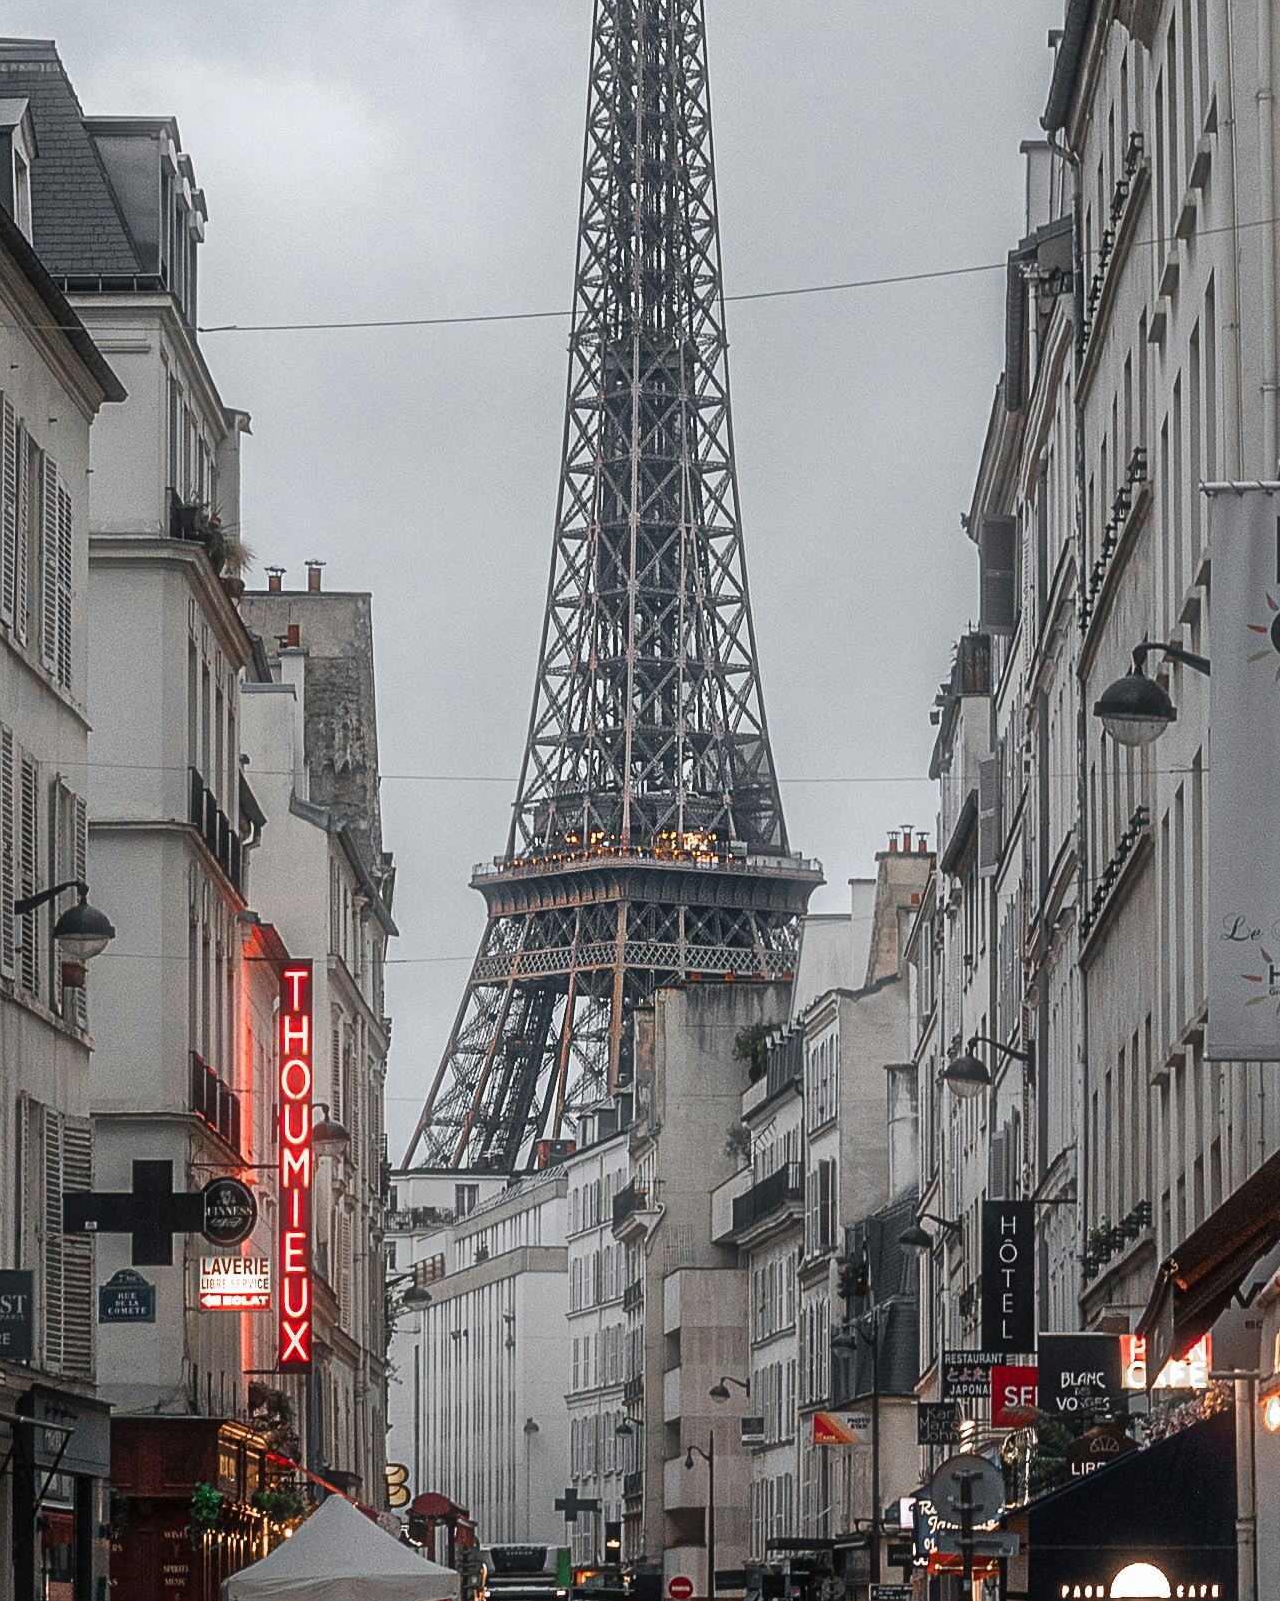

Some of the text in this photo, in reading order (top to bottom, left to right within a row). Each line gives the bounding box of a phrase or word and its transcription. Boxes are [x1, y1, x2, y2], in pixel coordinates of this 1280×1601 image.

[1221, 913, 1263, 942] Le
[282, 968, 311, 1362] THOUMIEUX
[206, 1205, 253, 1217] UINNESS
[202, 1258, 269, 1275] LAVERIE
[201, 1278, 269, 1289] LIBRE SERVICE
[1000, 1216, 1016, 1340] HÔTEL
[945, 1353, 1003, 1364] RESTAURANT
[947, 1367, 991, 1382] とよた
[1060, 1371, 1106, 1389] BLANC
[1004, 1386, 1038, 1407] SF
[920, 1429, 959, 1442] John
